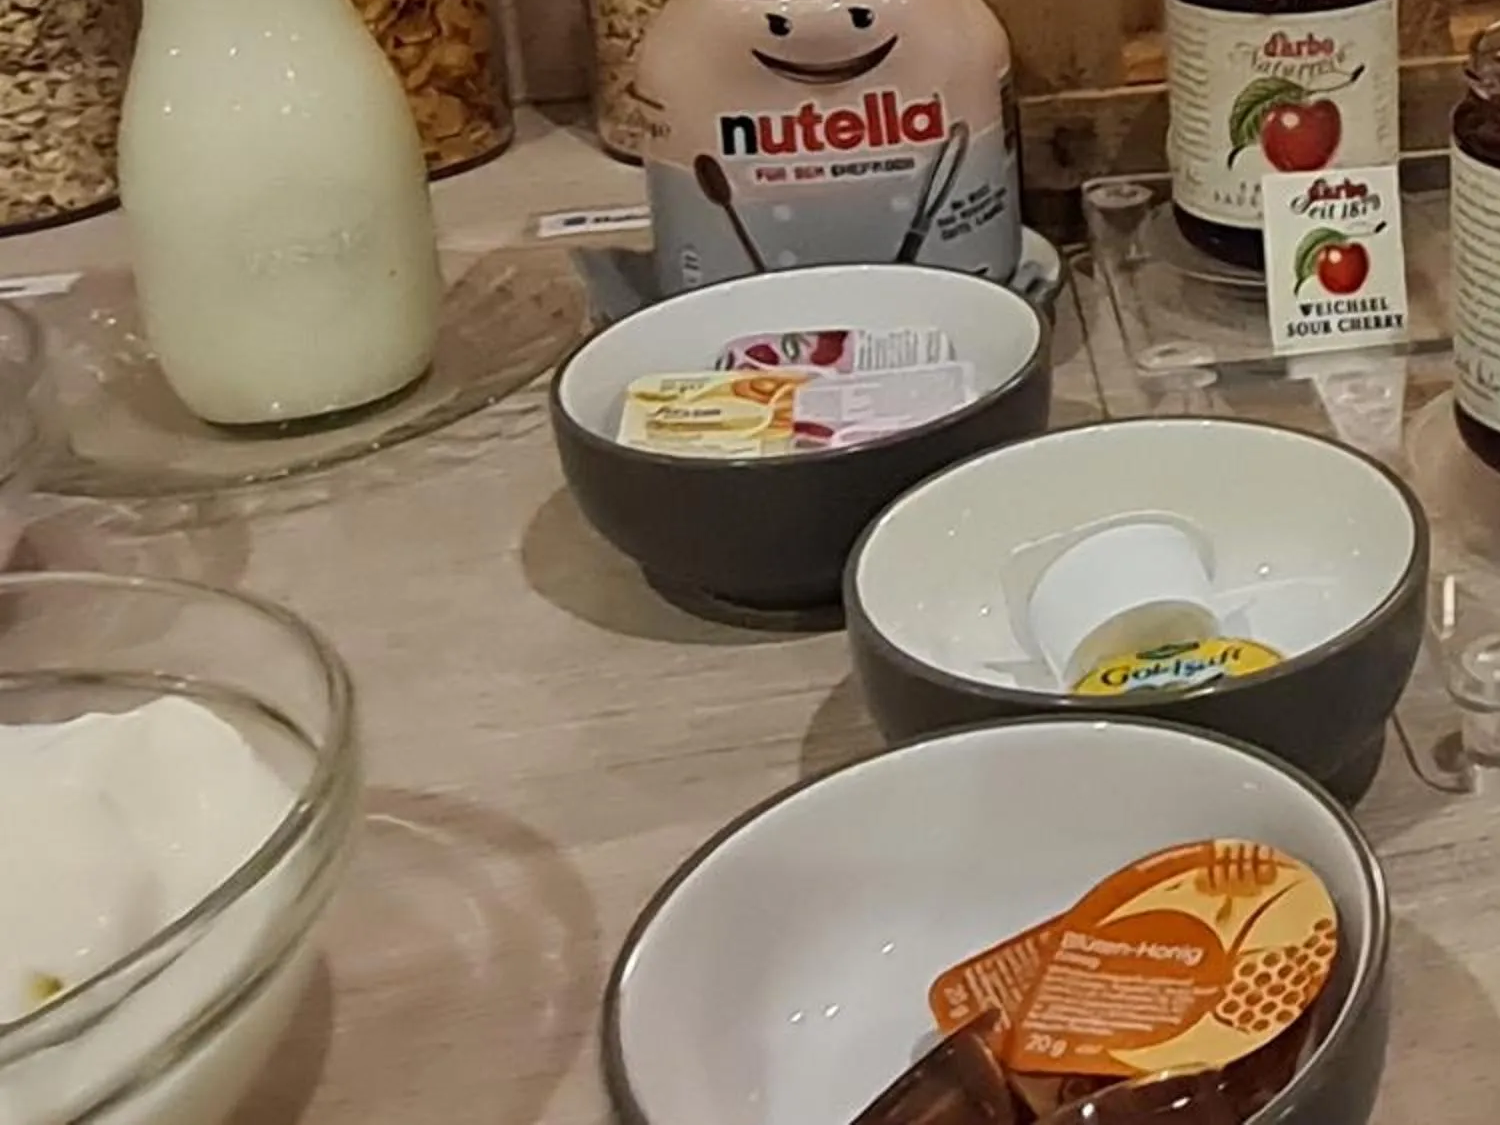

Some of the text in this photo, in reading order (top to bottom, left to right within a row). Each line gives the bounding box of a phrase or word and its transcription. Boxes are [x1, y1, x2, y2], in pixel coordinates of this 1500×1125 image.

[721, 91, 945, 156] nutella
[1299, 296, 1389, 317] WEICHSEL
[1287, 314, 1404, 338] SOUR CHERRY
